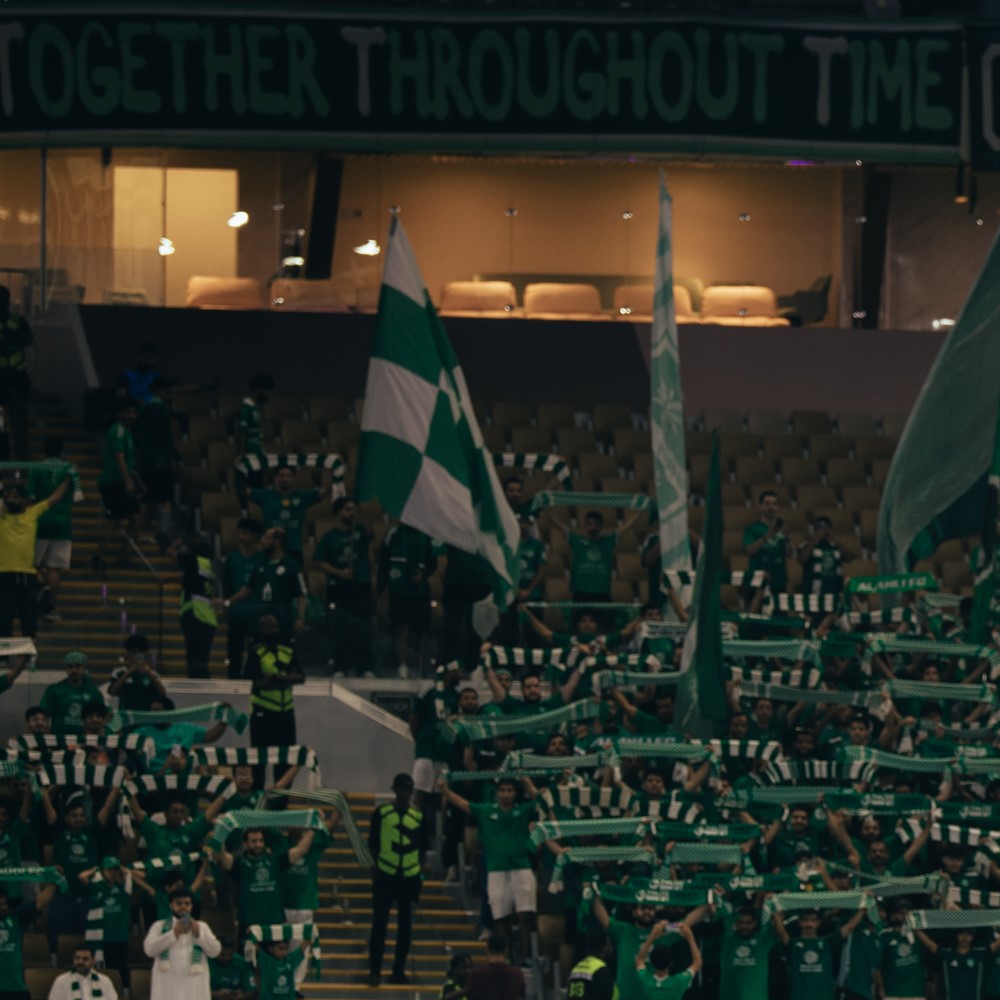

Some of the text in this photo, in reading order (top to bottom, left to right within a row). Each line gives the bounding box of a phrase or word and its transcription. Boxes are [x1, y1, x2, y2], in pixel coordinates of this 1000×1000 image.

[0, 21, 954, 131] TOGETHER THROUGHOUT TIME
